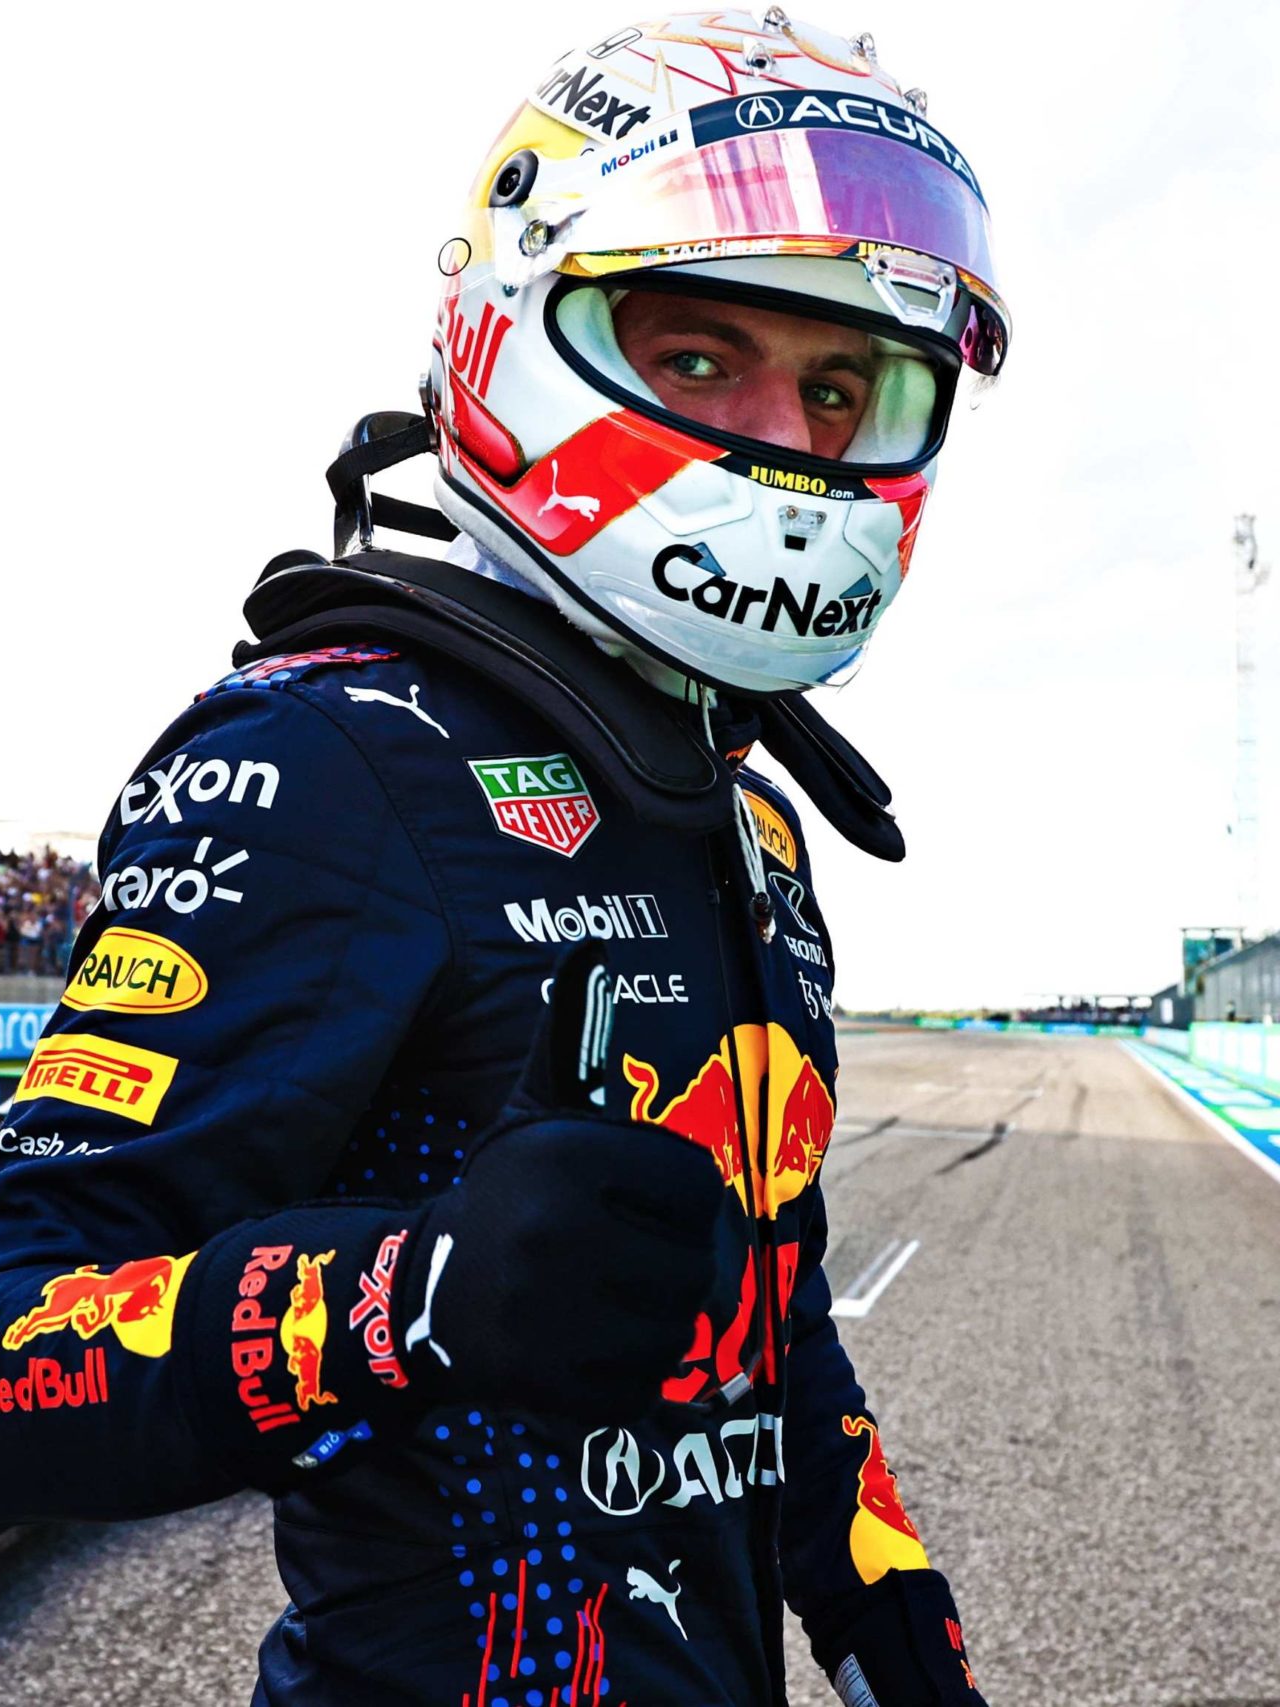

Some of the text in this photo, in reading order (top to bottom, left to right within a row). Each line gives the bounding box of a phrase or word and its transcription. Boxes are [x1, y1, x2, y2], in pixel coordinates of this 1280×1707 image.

[601, 140, 655, 176] Mobil
[652, 544, 882, 637] CarNext
[481, 763, 575, 794] TAG
[500, 800, 592, 849] HEUER
[504, 897, 634, 942] Mobil
[77, 953, 180, 999] RAUCH
[24, 1048, 153, 1106] PIRELLI
